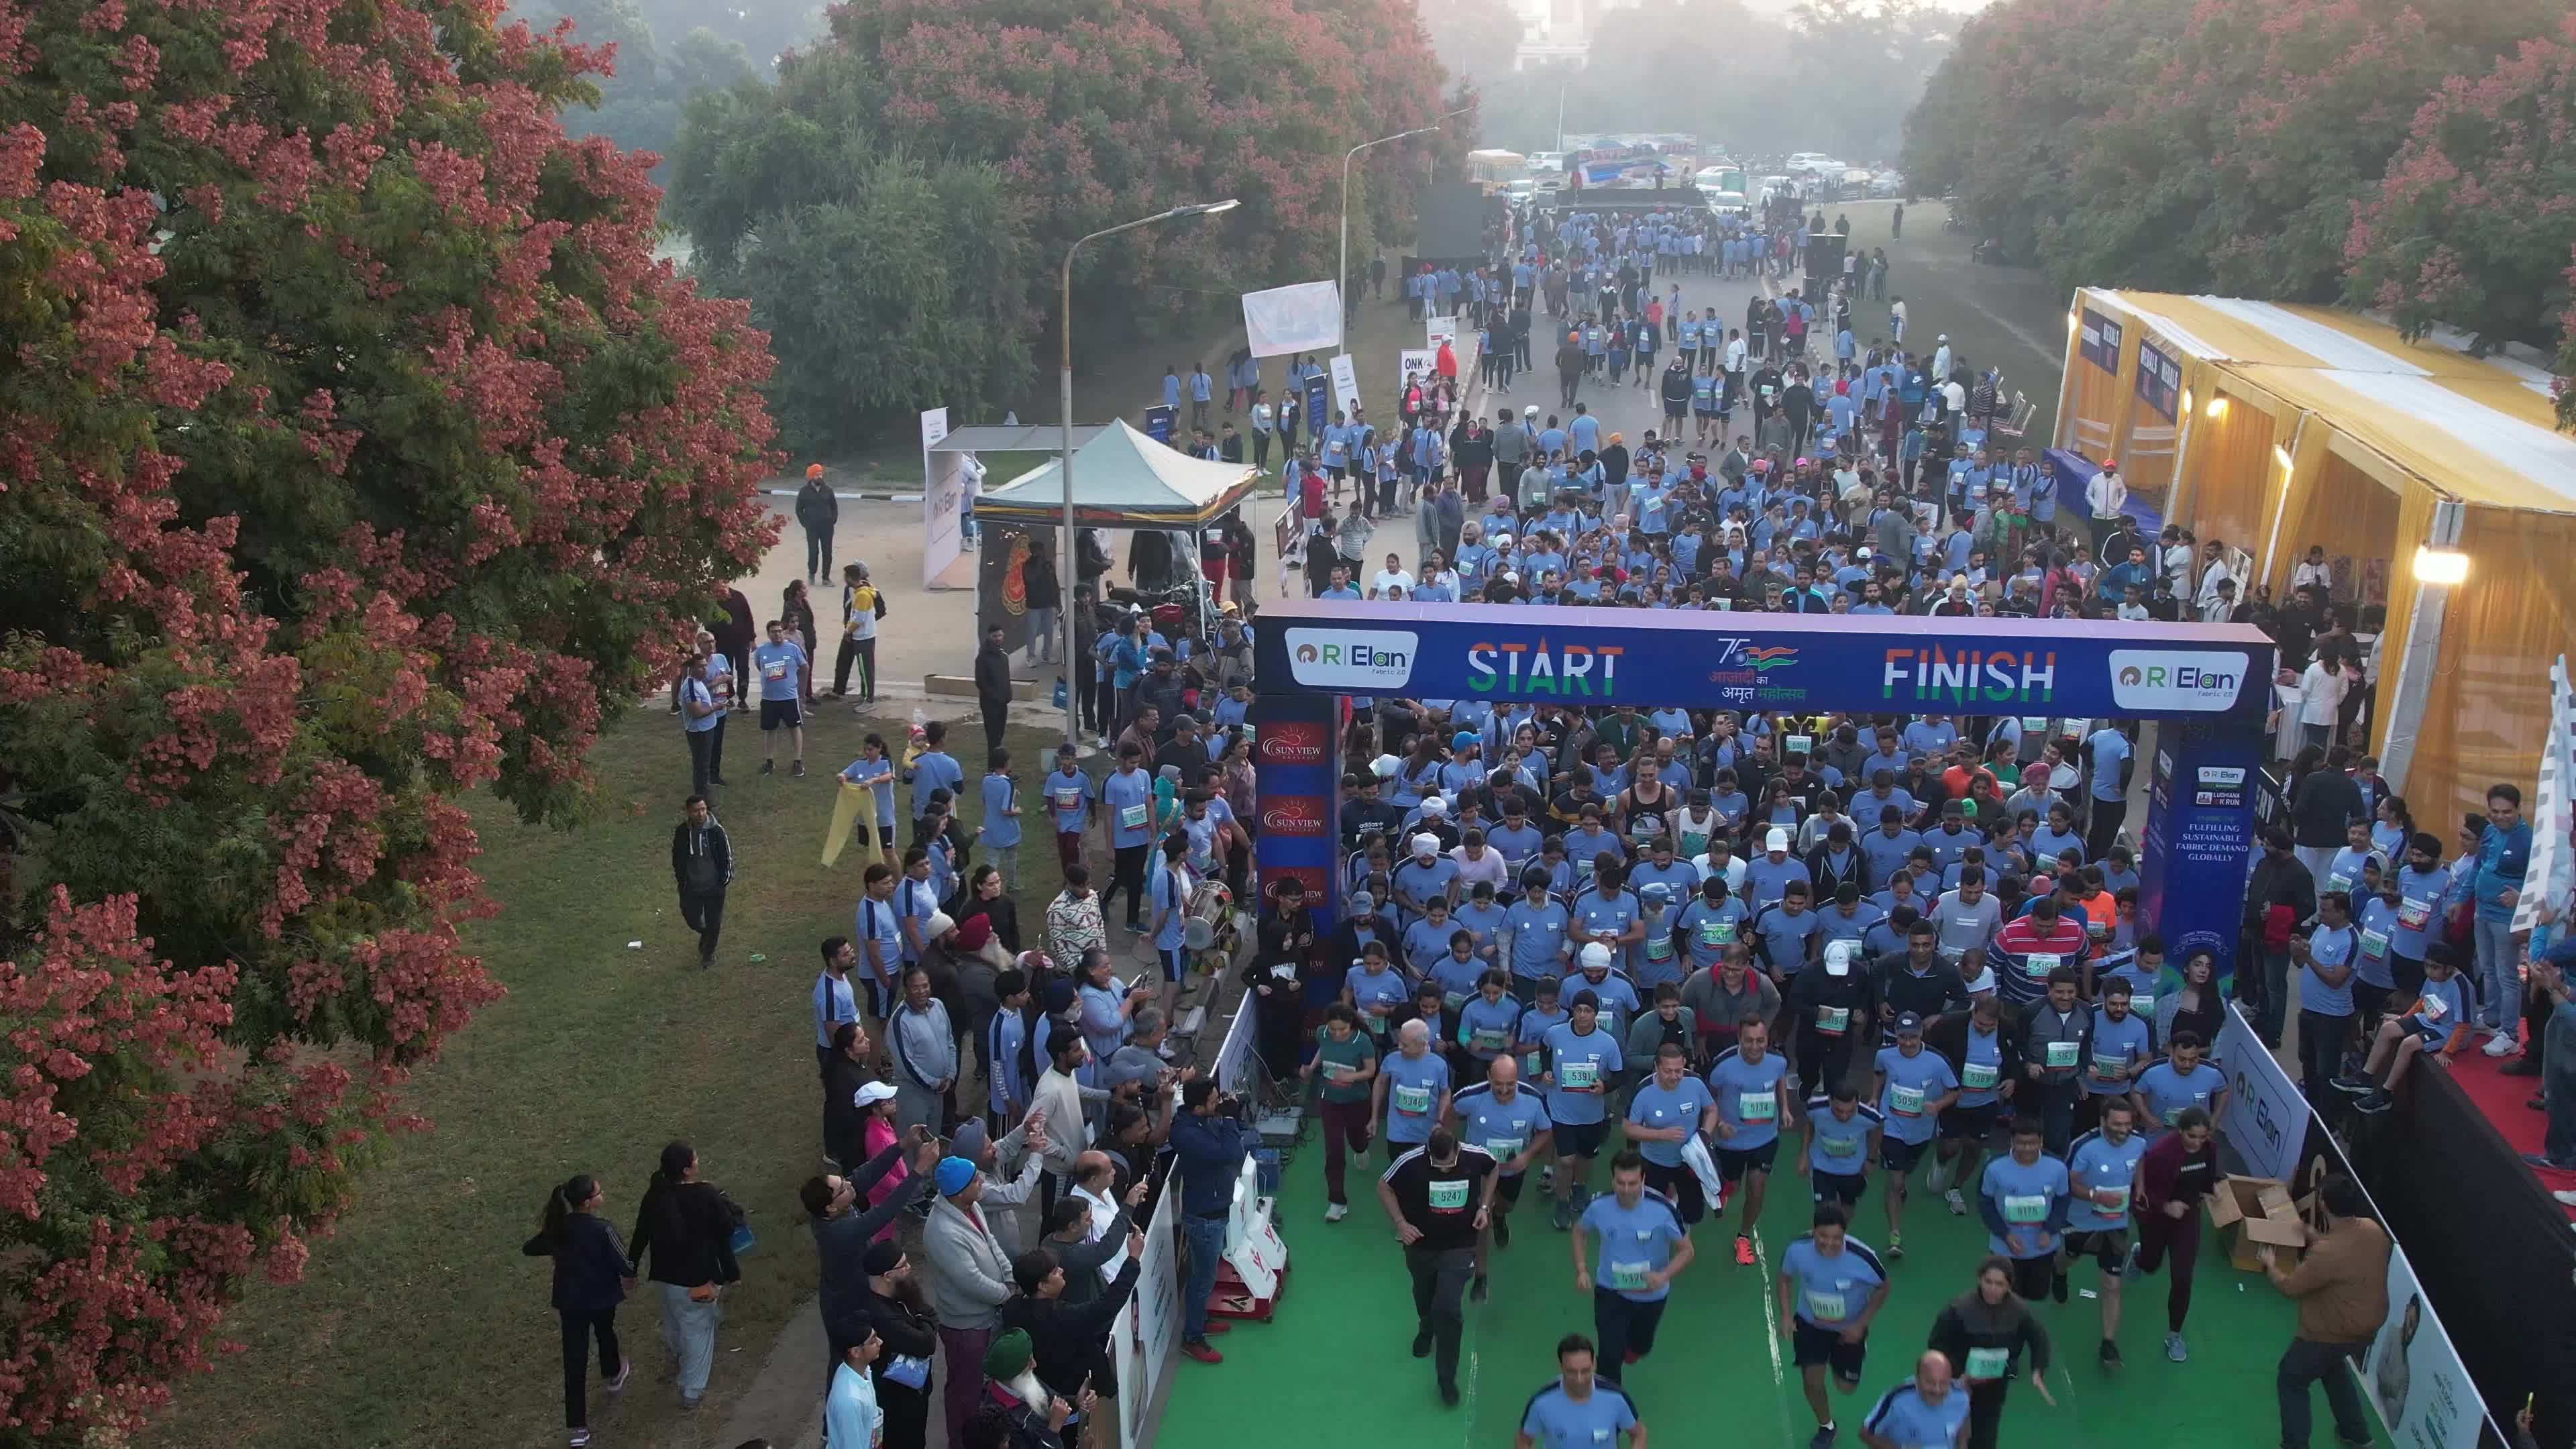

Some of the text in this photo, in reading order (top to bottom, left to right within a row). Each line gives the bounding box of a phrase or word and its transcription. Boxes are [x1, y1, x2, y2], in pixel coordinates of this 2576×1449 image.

[2141, 345, 2157, 374] MEDALS
[2161, 361, 2178, 392] MEDALS
[1322, 644, 1406, 667] R Elan
[1466, 634, 1624, 697] START
[1756, 676, 1768, 685] का
[1884, 641, 2056, 708] FINISH
[2147, 666, 2234, 689] R Elan
[1722, 686, 1755, 704] अमृत
[1275, 747, 1295, 755] SUN
[2189, 823, 2241, 832] FULFILLING
[2182, 833, 2242, 843] SUSTAINABLE
[2176, 843, 2249, 853] FABRIC DEMAND
[2188, 853, 2234, 861] GLOBALLY
[1572, 1072, 1591, 1081] 5391
[2257, 1096, 2281, 1151] Elan
[1441, 1191, 1461, 1202] 5247
